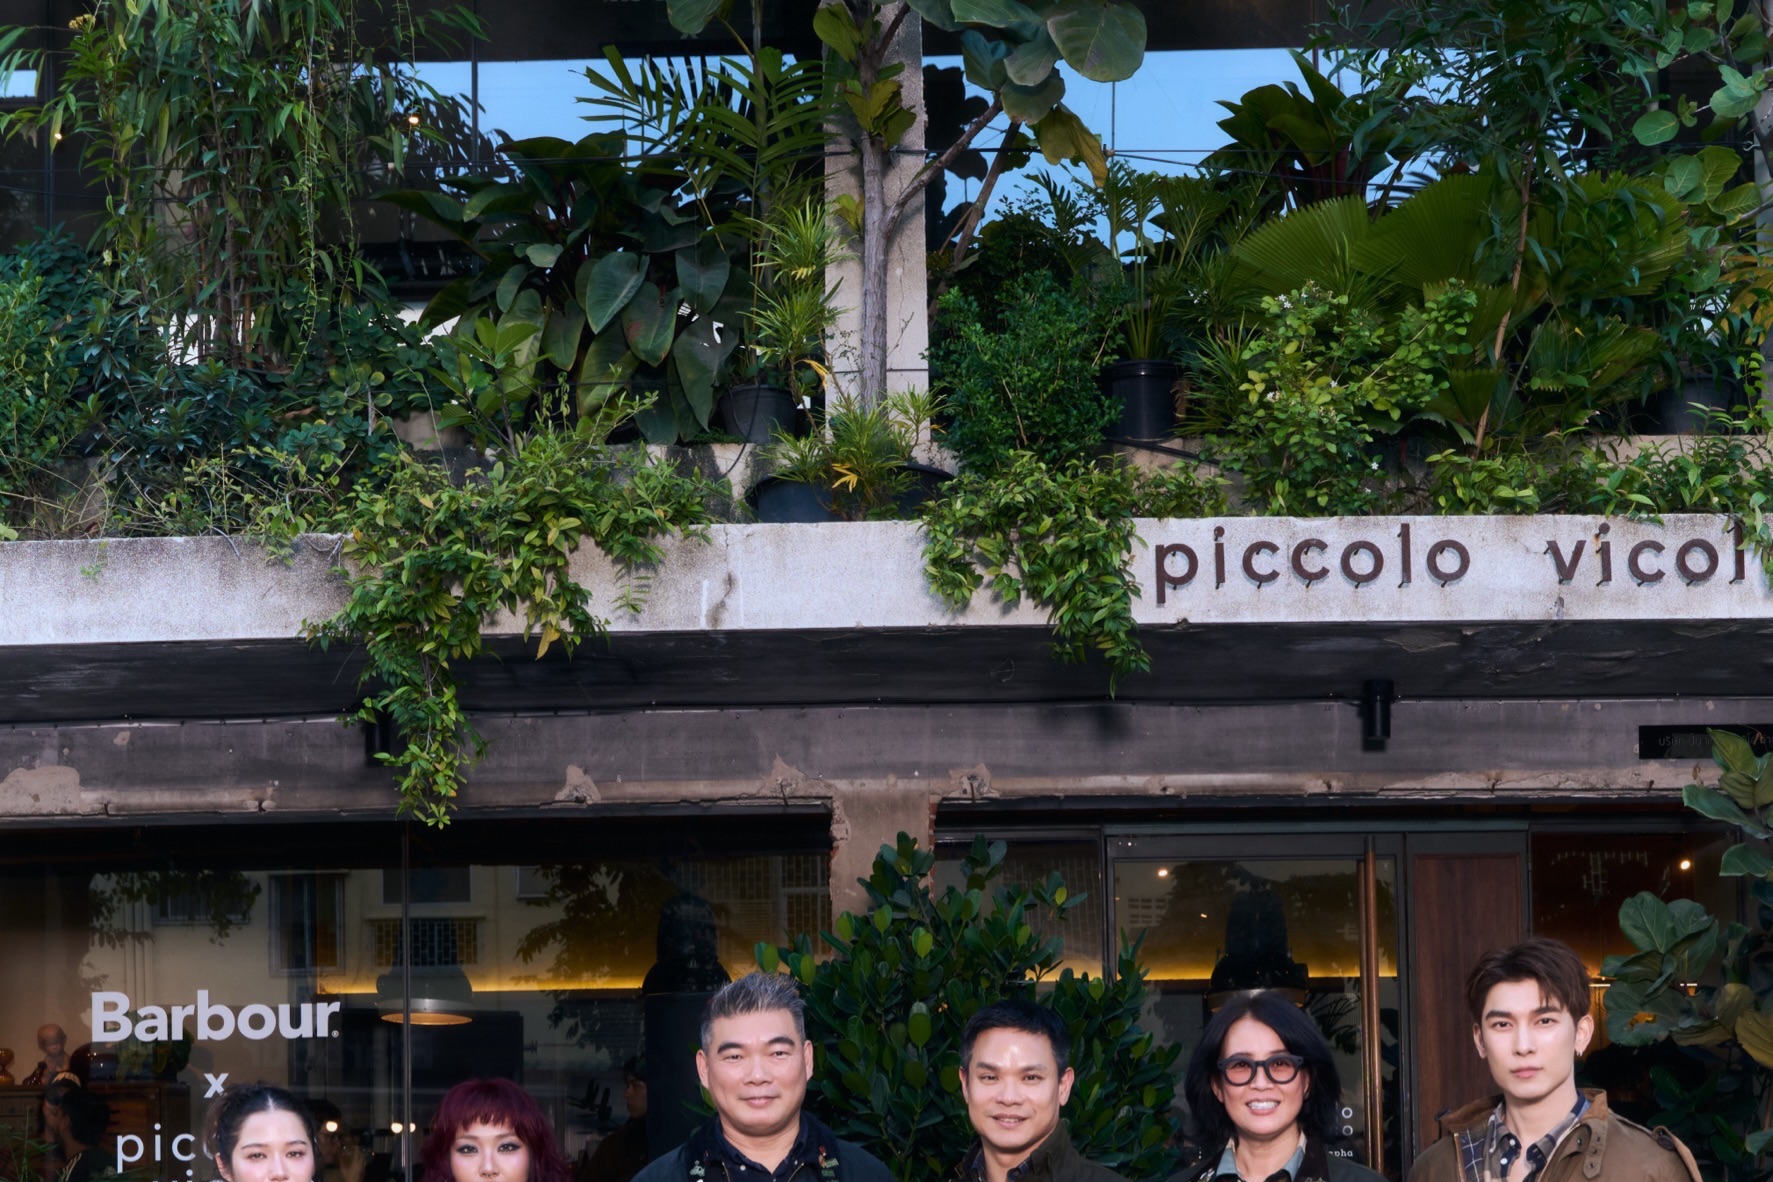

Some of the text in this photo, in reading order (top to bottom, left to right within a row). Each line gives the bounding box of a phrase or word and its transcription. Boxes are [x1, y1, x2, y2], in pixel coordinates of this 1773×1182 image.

[1155, 519, 1773, 605] piccolo vicol
[91, 989, 341, 1042] Barbour
